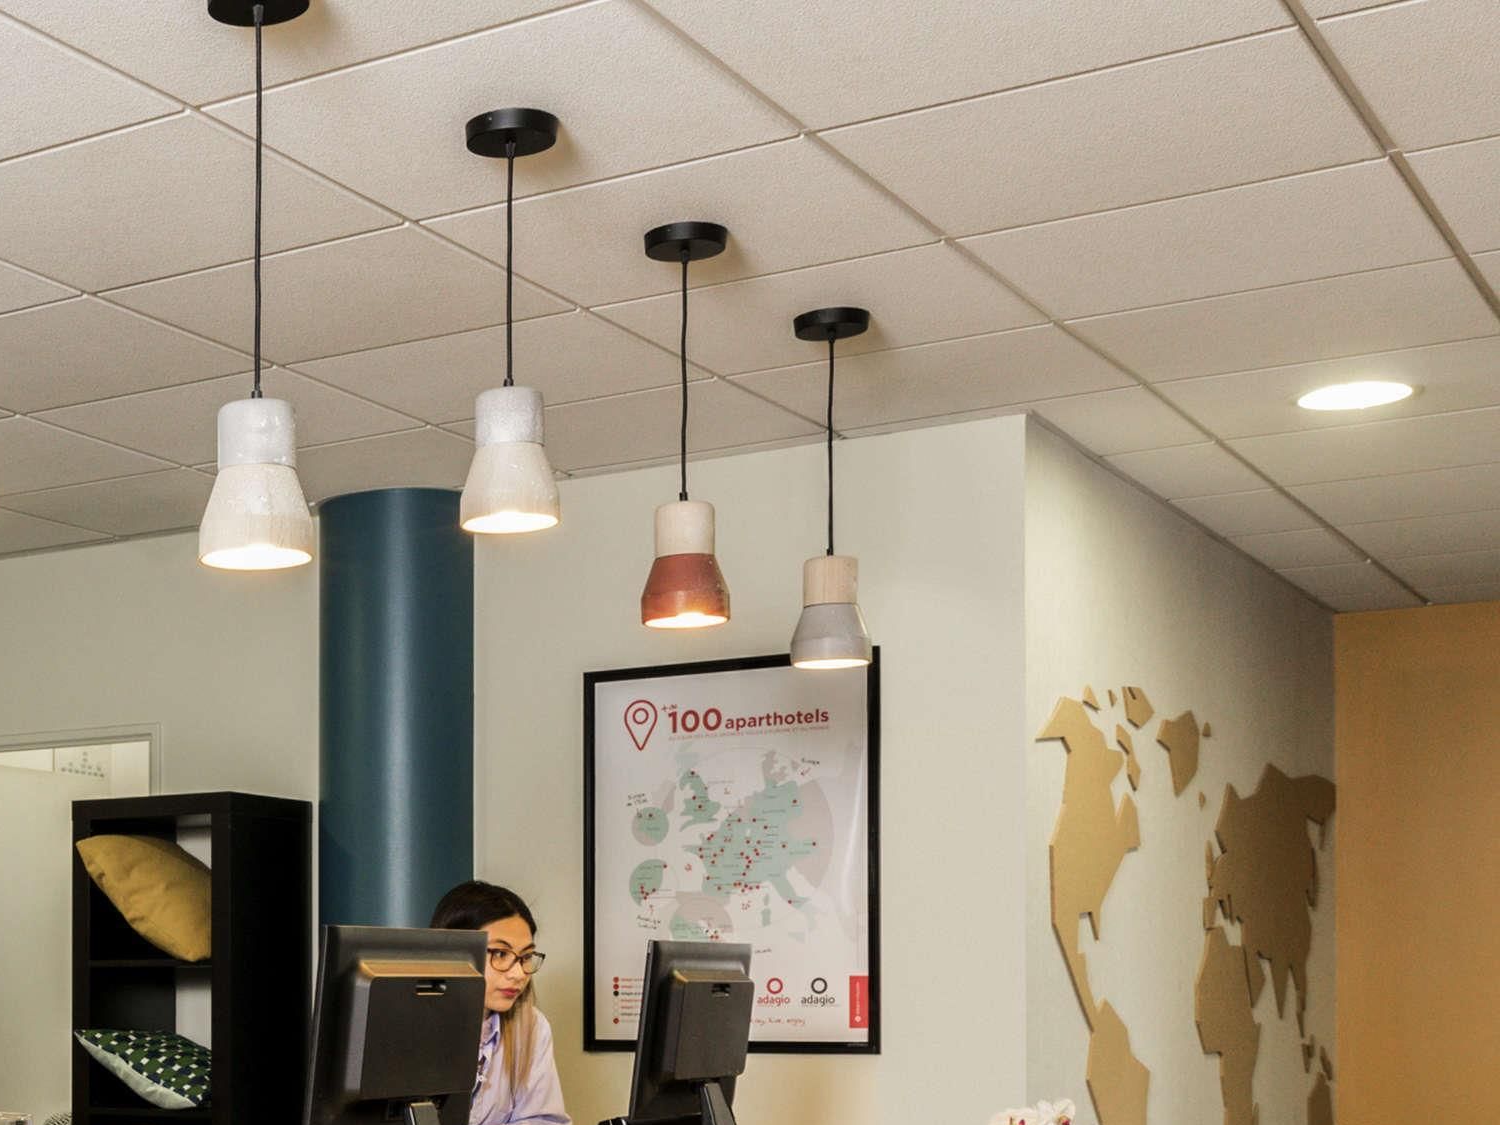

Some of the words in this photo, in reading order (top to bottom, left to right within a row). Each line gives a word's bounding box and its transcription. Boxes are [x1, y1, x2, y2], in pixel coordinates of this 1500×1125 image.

[668, 707, 722, 733] 100
[725, 708, 829, 731] aparthotels
[757, 995, 790, 1006] adagio
[801, 995, 835, 1006] adagio
